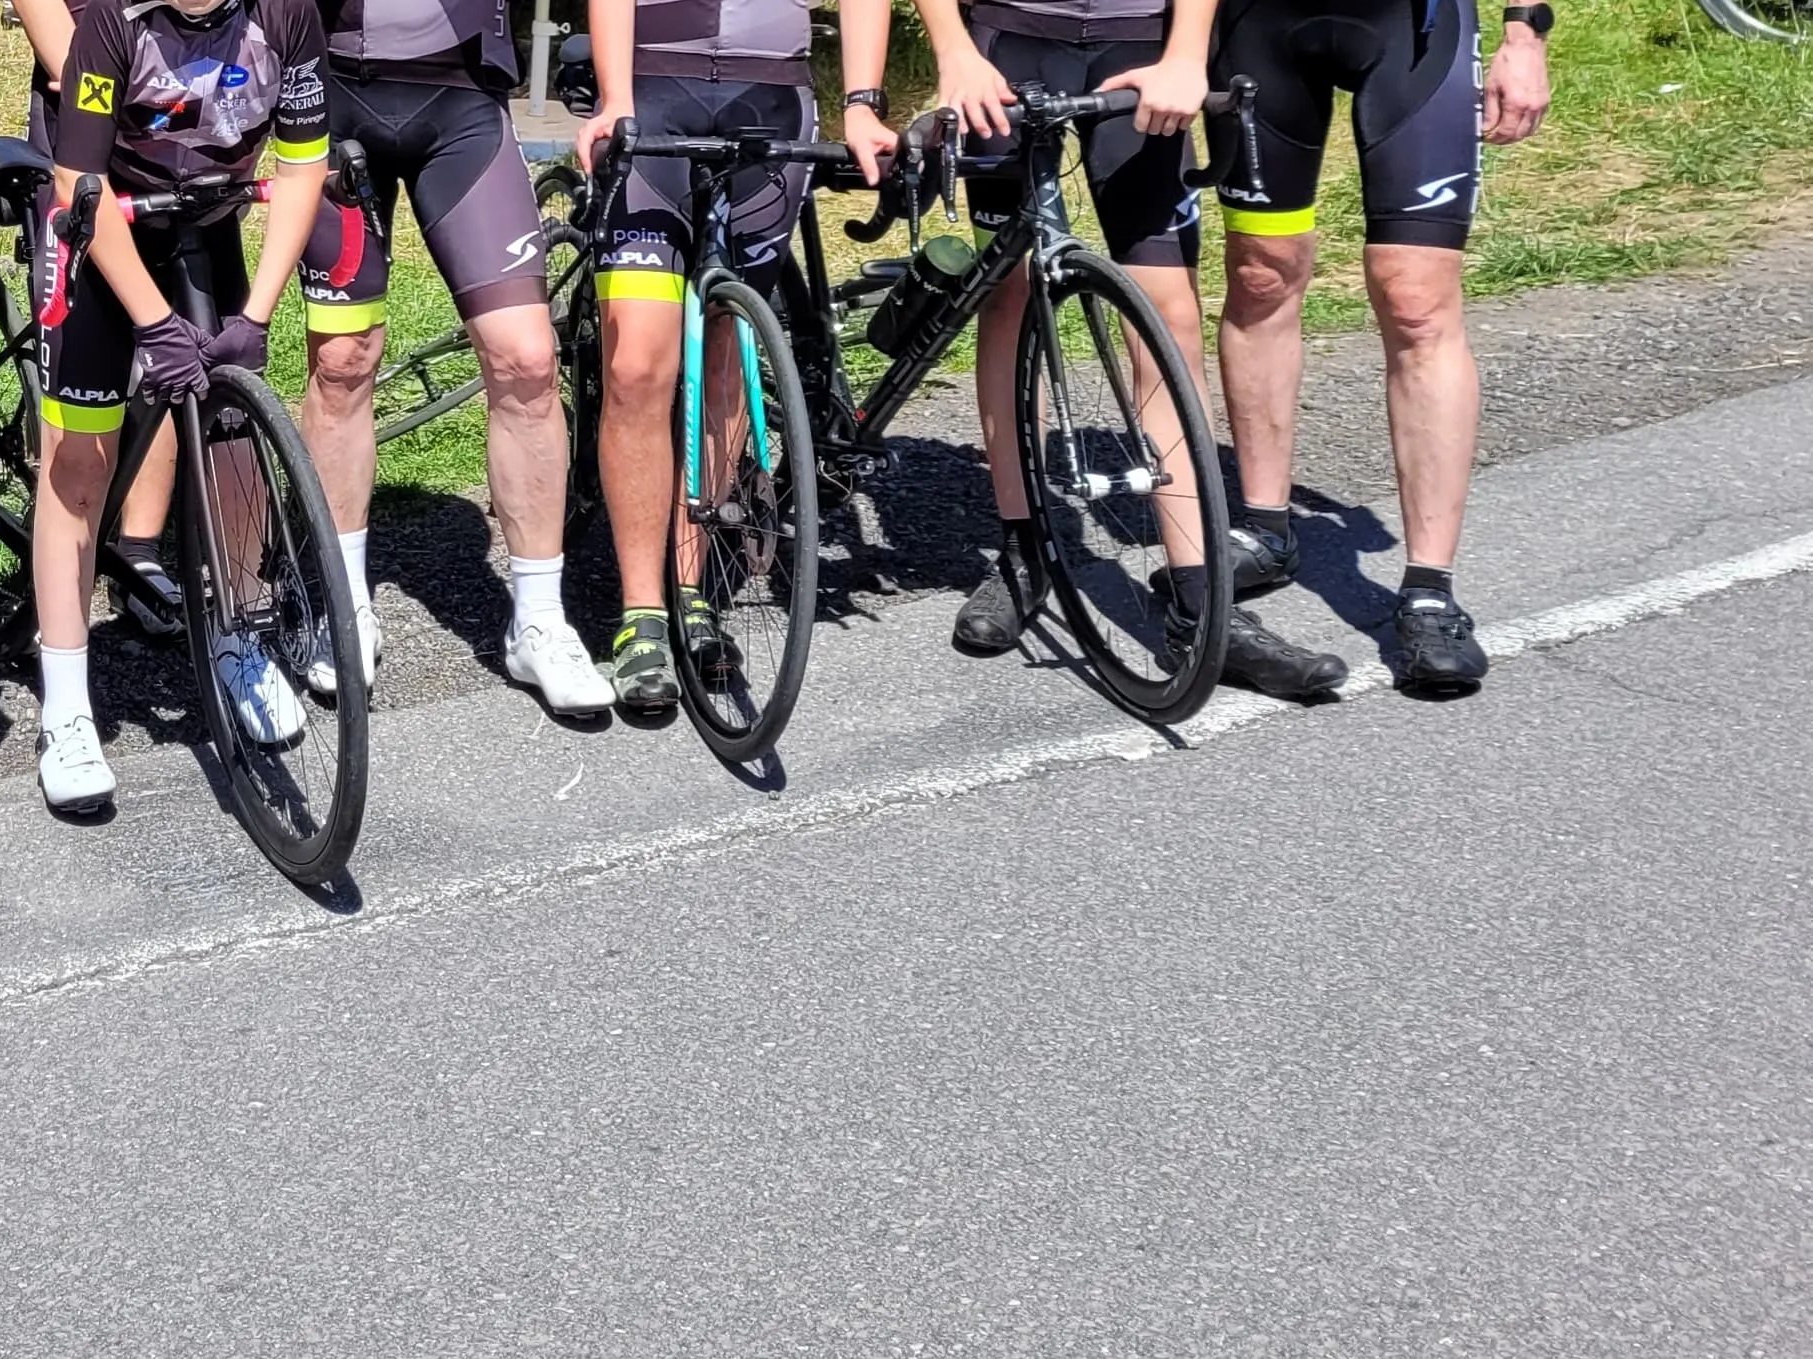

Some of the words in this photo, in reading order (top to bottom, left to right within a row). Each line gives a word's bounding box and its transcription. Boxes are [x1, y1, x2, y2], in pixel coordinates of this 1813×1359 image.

[296, 112, 326, 126] Piringer
[973, 211, 1011, 226] ALP
[612, 227, 668, 245] point
[599, 251, 664, 267] ALPLA
[58, 385, 120, 402] ALPLA
